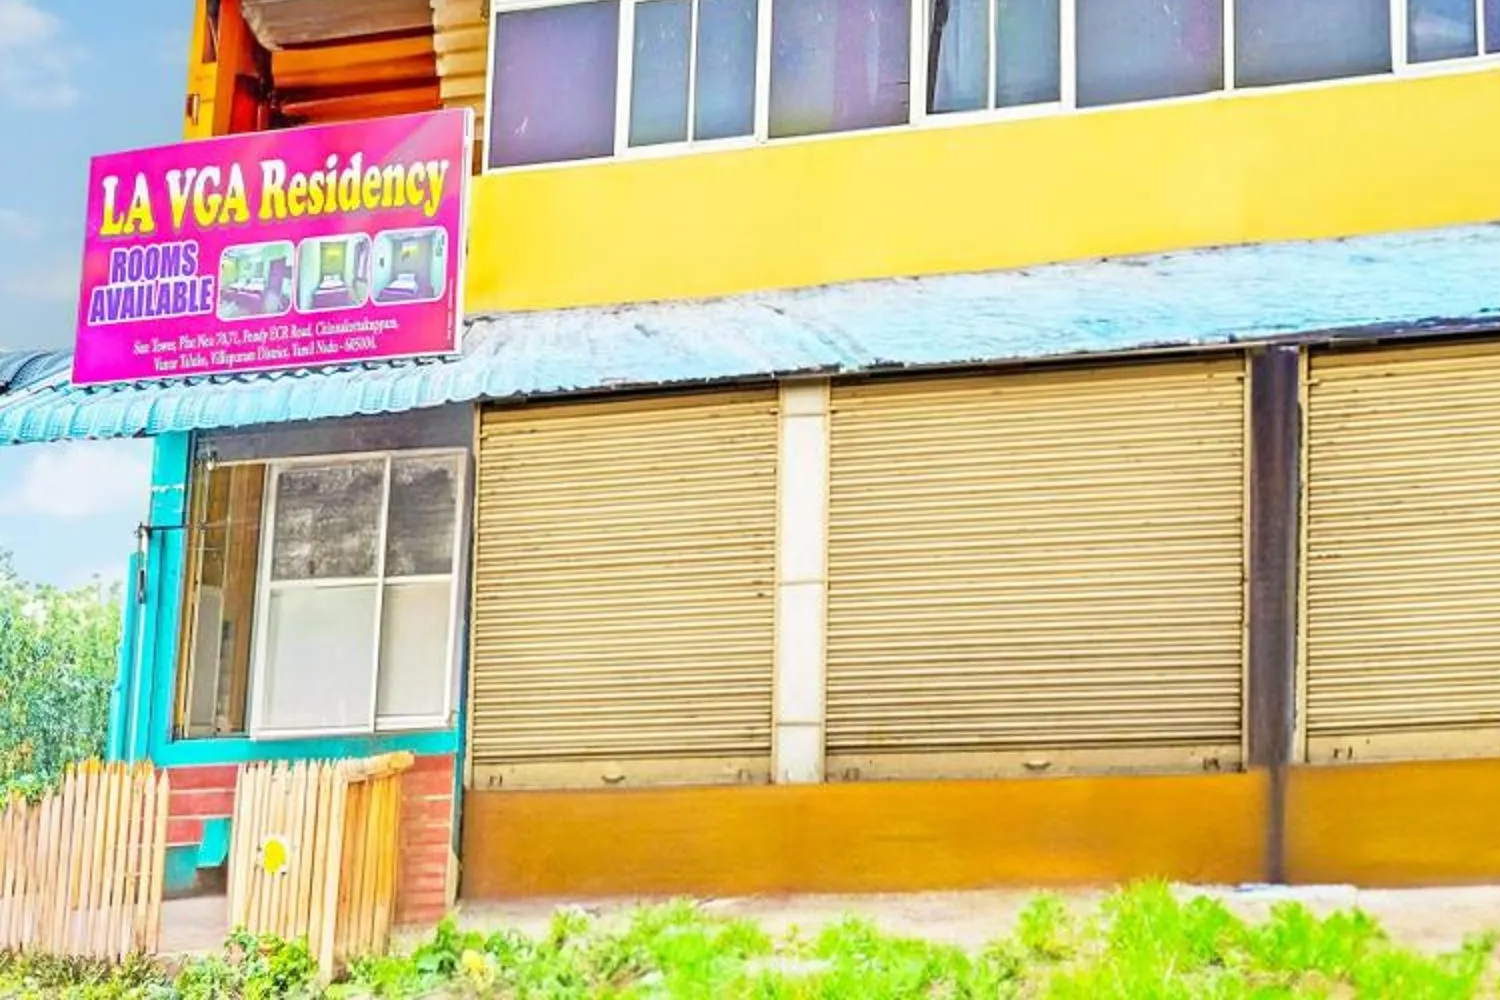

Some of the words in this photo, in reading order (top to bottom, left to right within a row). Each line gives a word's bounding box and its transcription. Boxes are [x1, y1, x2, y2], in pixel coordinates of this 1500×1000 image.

[99, 173, 156, 235] LA
[167, 162, 250, 230] VGA
[259, 152, 450, 219] Residency
[112, 243, 198, 283] ROOMS
[90, 277, 213, 322] AVAILABLE
